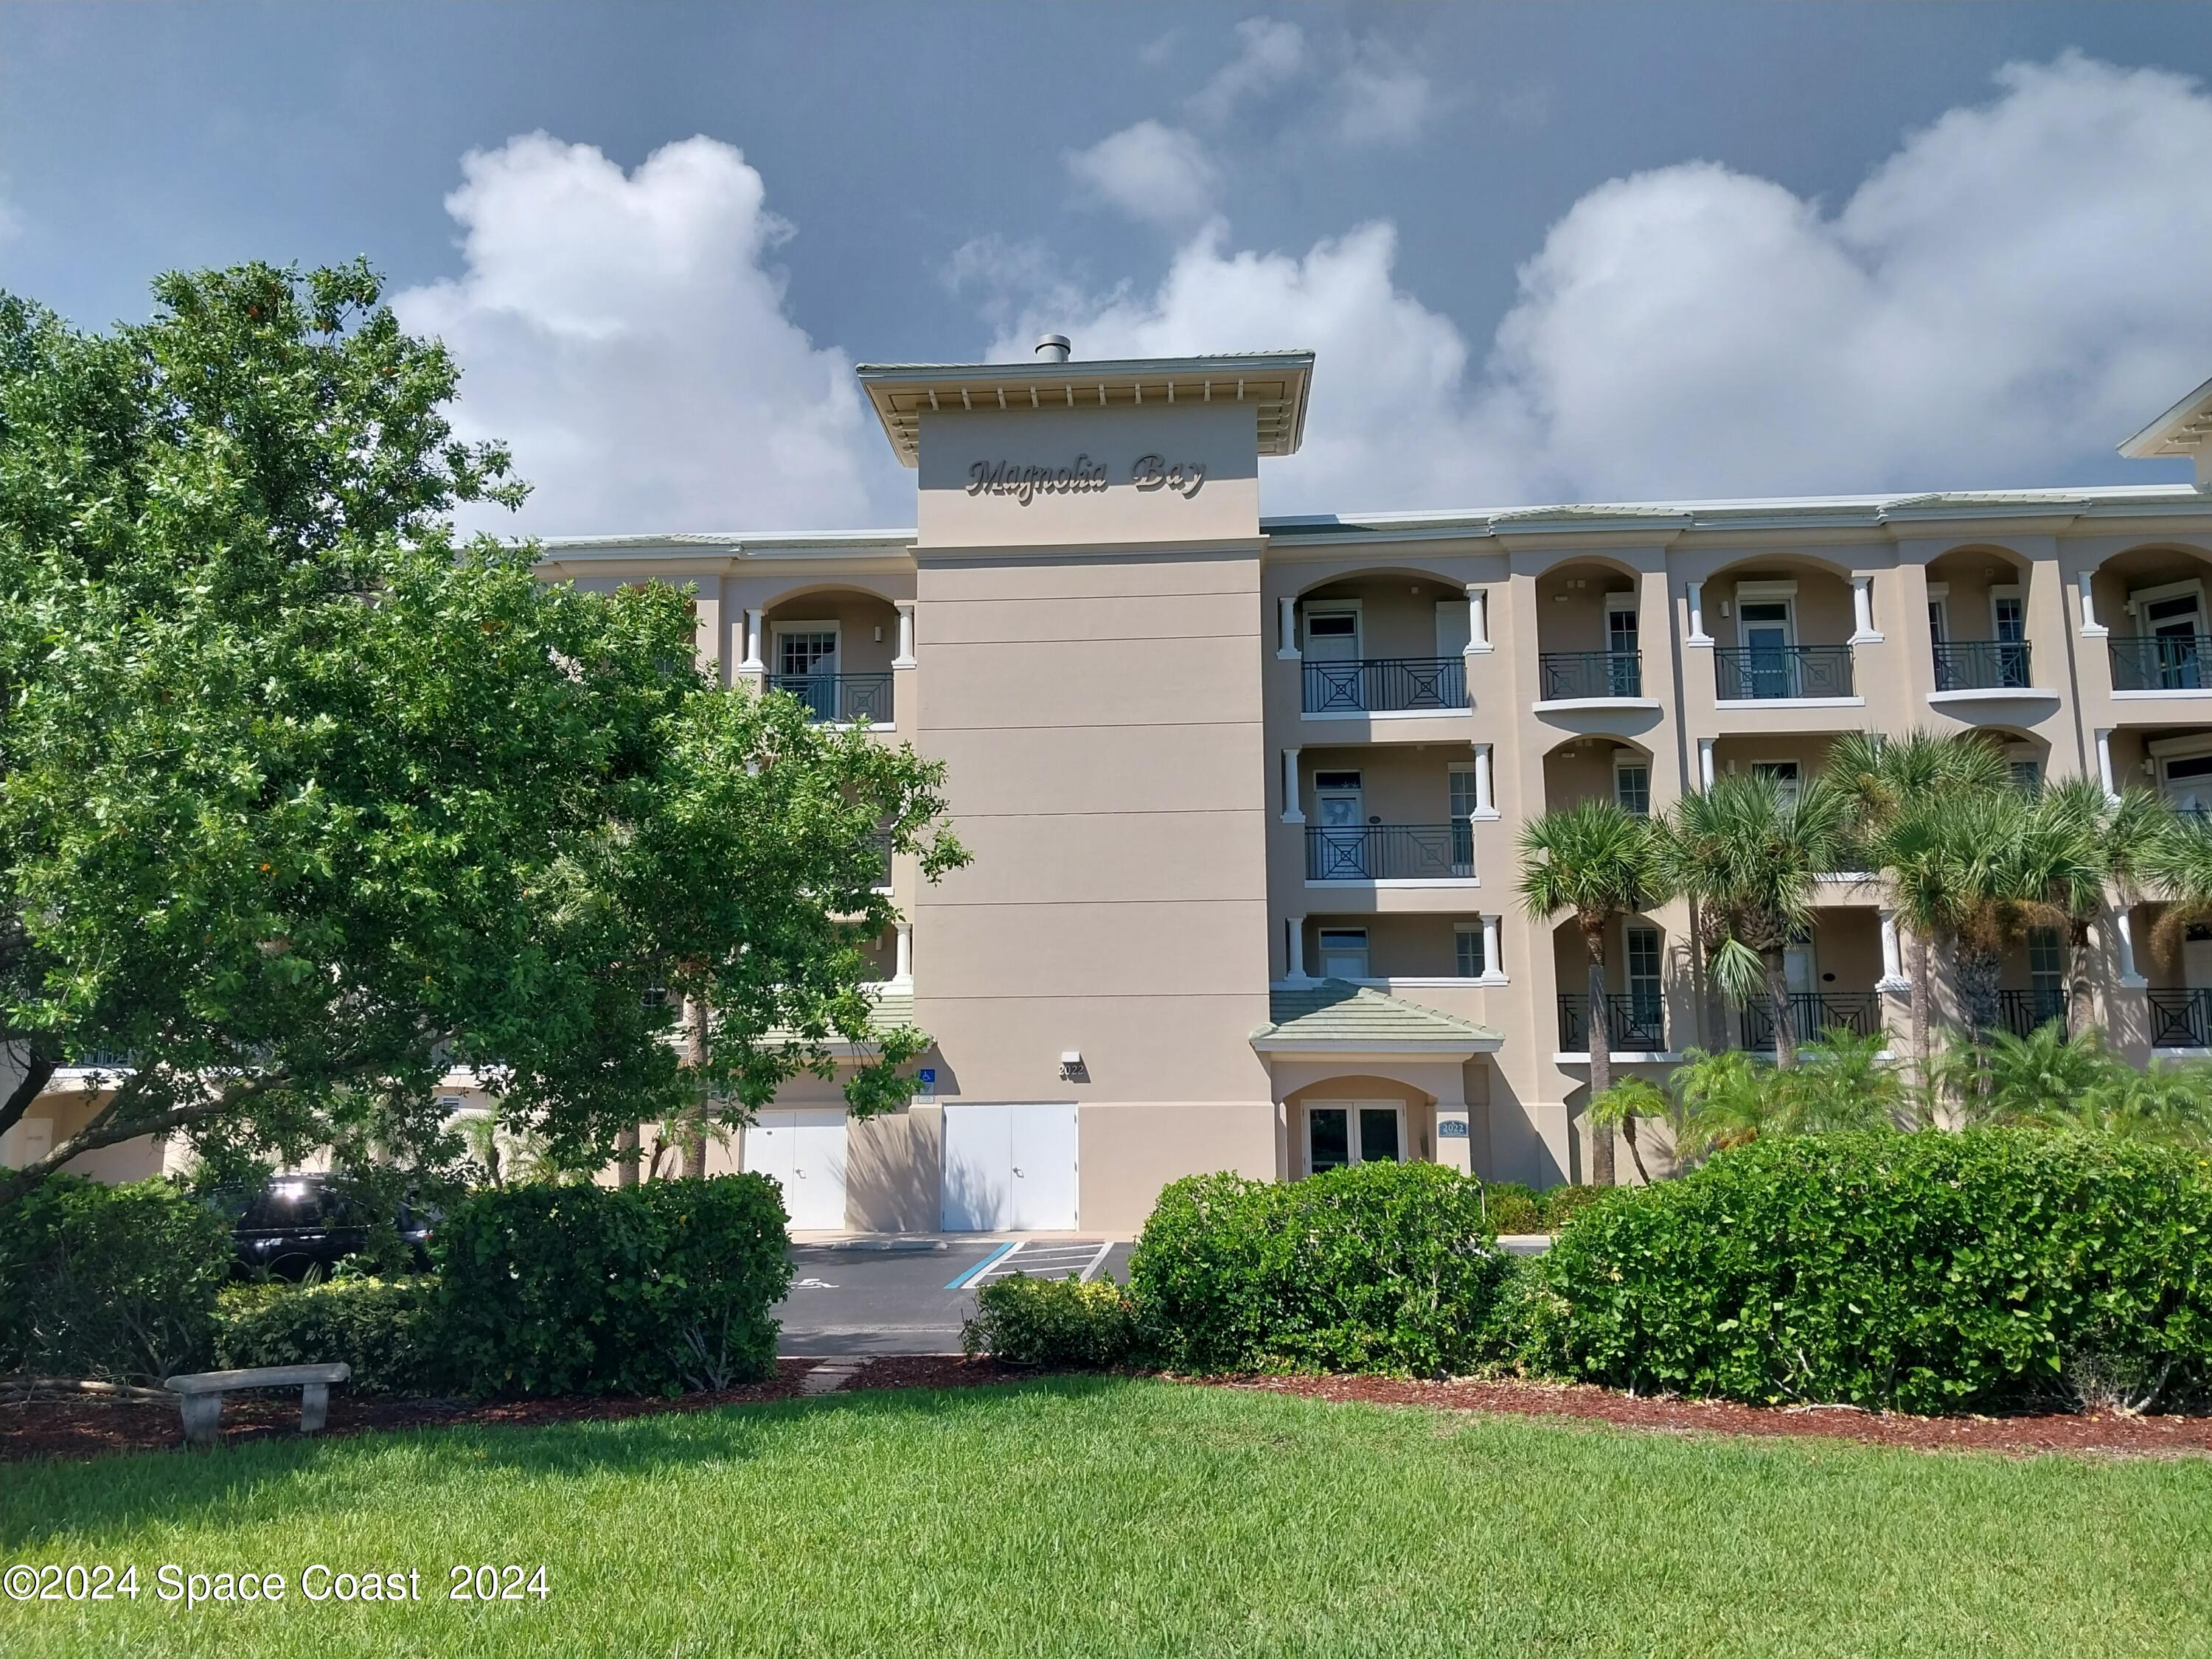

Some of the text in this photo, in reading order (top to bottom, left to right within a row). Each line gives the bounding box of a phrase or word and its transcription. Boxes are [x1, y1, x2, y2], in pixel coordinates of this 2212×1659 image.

[965, 453, 1206, 504] Magnolia Bay
[1058, 1065, 1084, 1075] 2022
[1443, 1124, 1464, 1133] 2022
